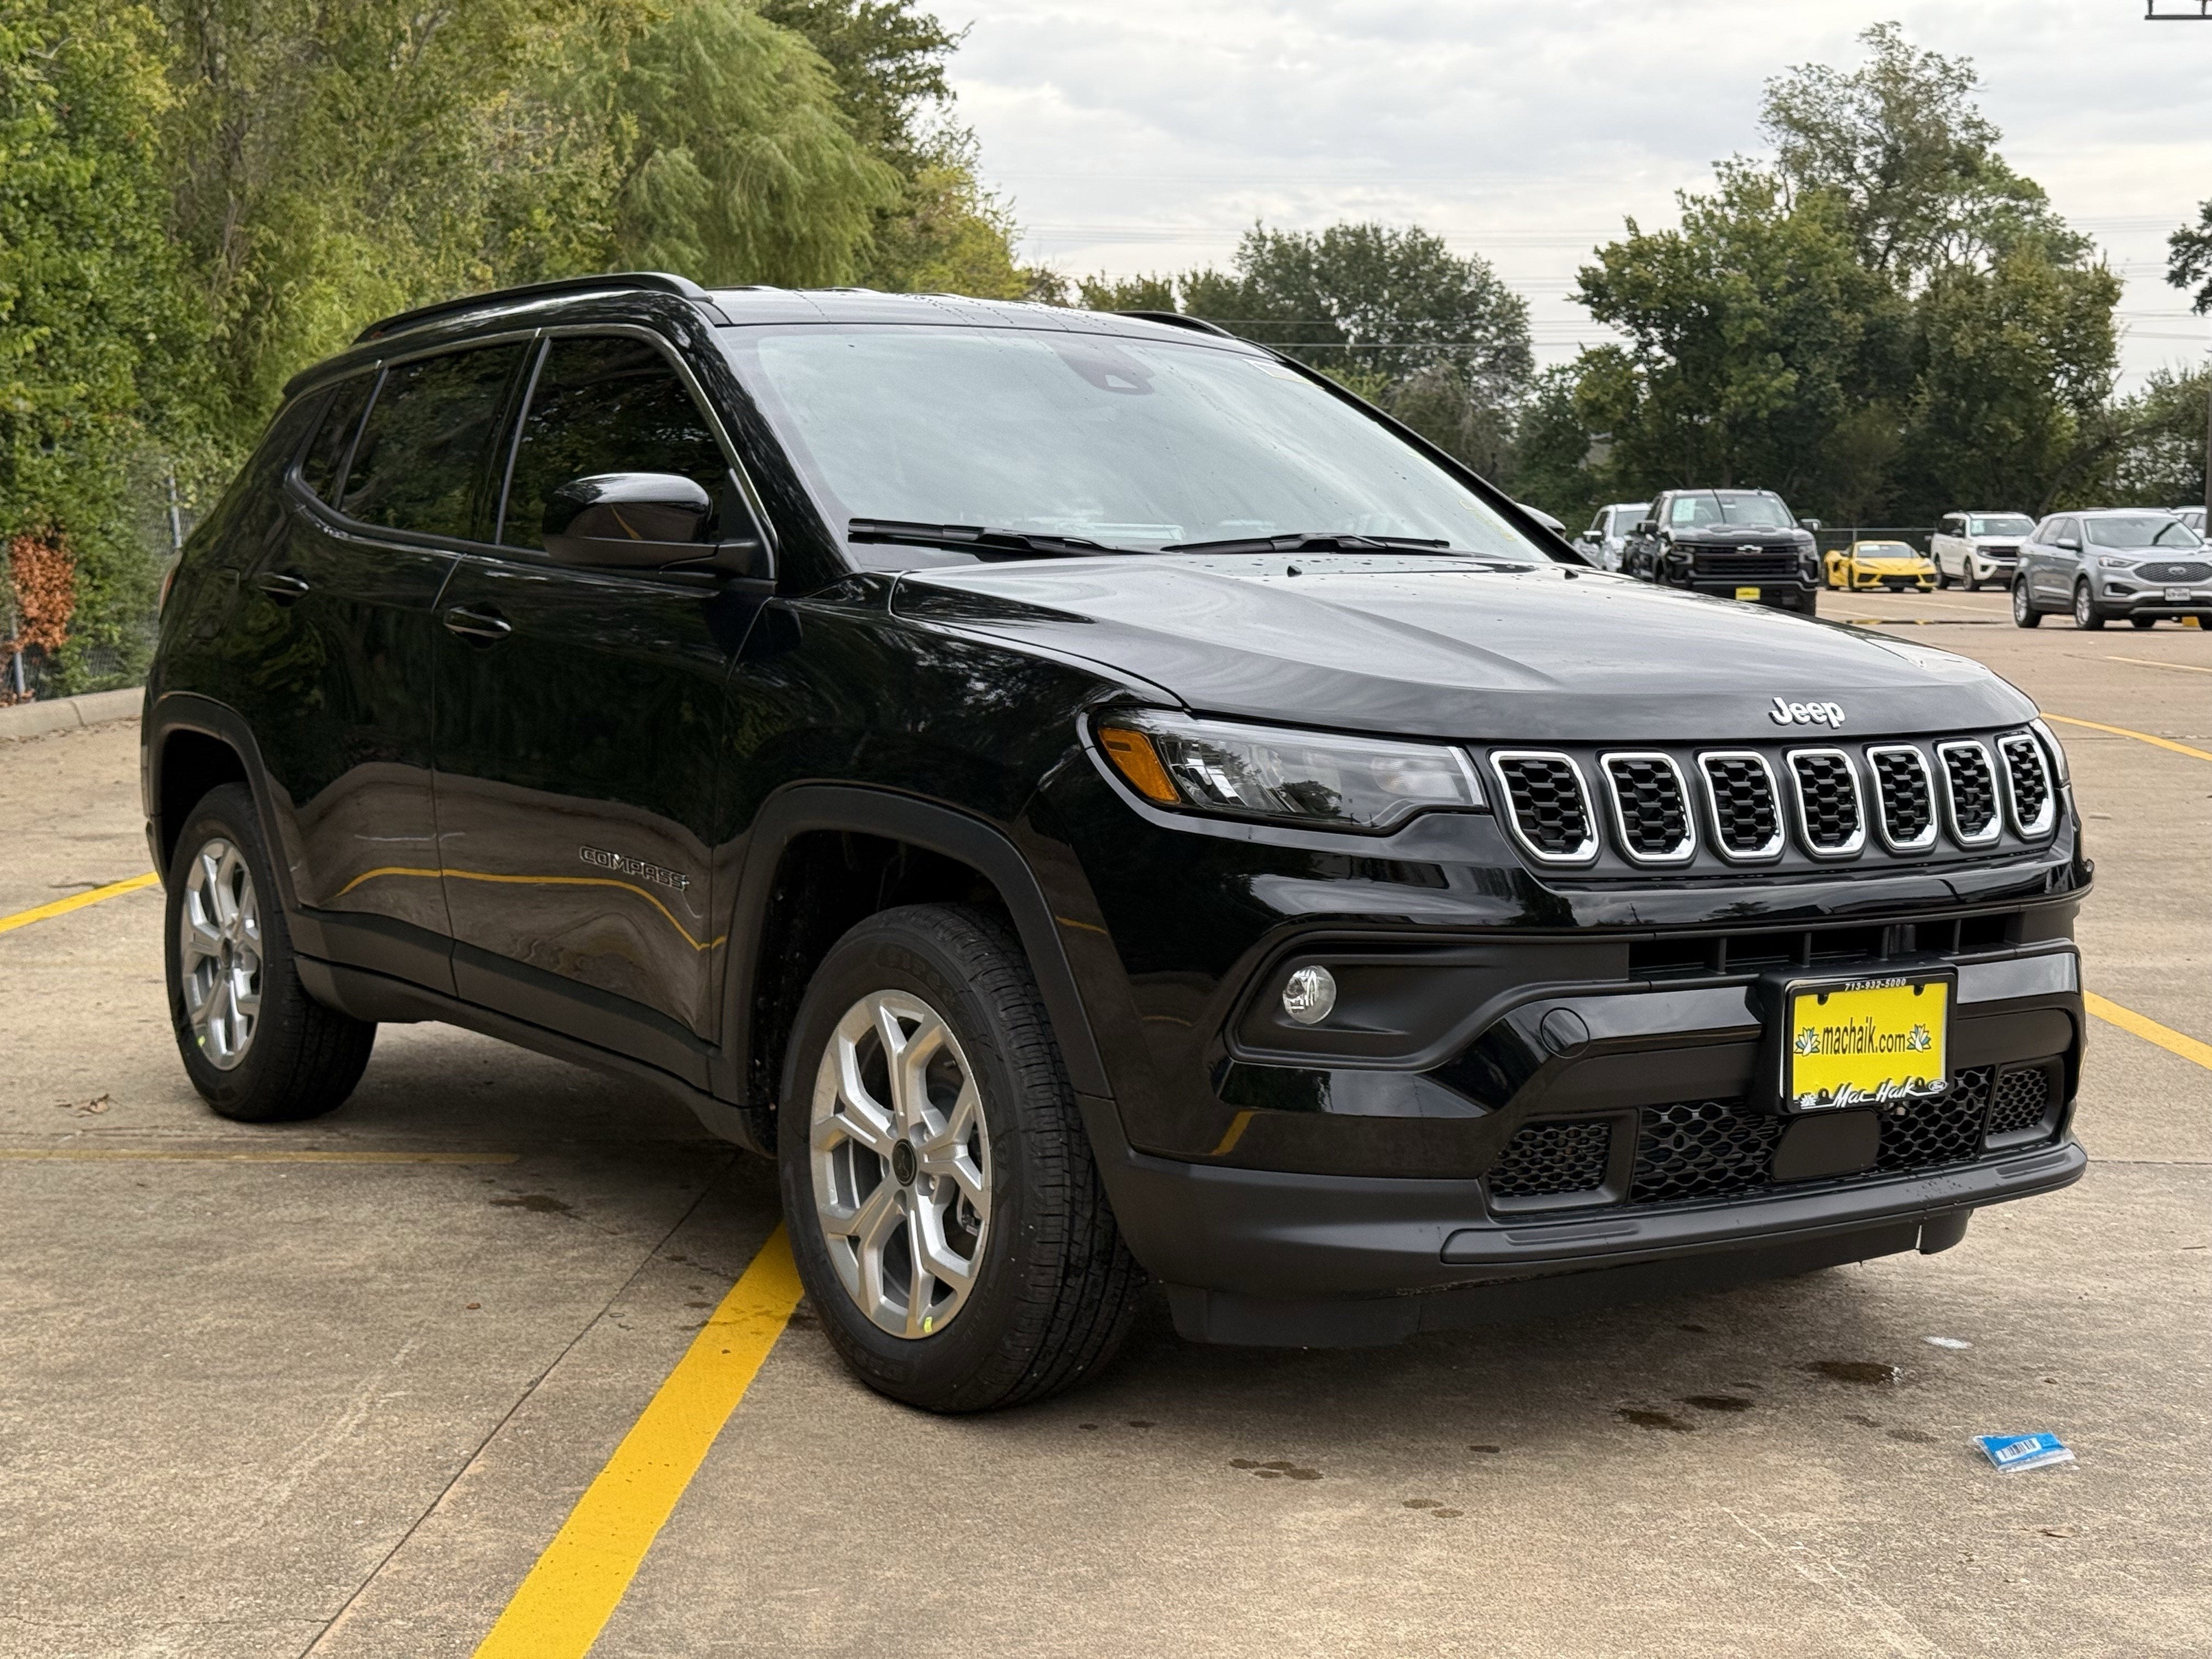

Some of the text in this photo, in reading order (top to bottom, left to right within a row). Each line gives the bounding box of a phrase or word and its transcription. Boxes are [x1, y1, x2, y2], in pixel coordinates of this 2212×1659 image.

[1768, 697, 1846, 729] Jeep
[579, 845, 689, 890] COMPASS
[1821, 1016, 1905, 1055] machaik.com
[1833, 1082, 1874, 1108] Mac
[1875, 1076, 1916, 1103] Haik
